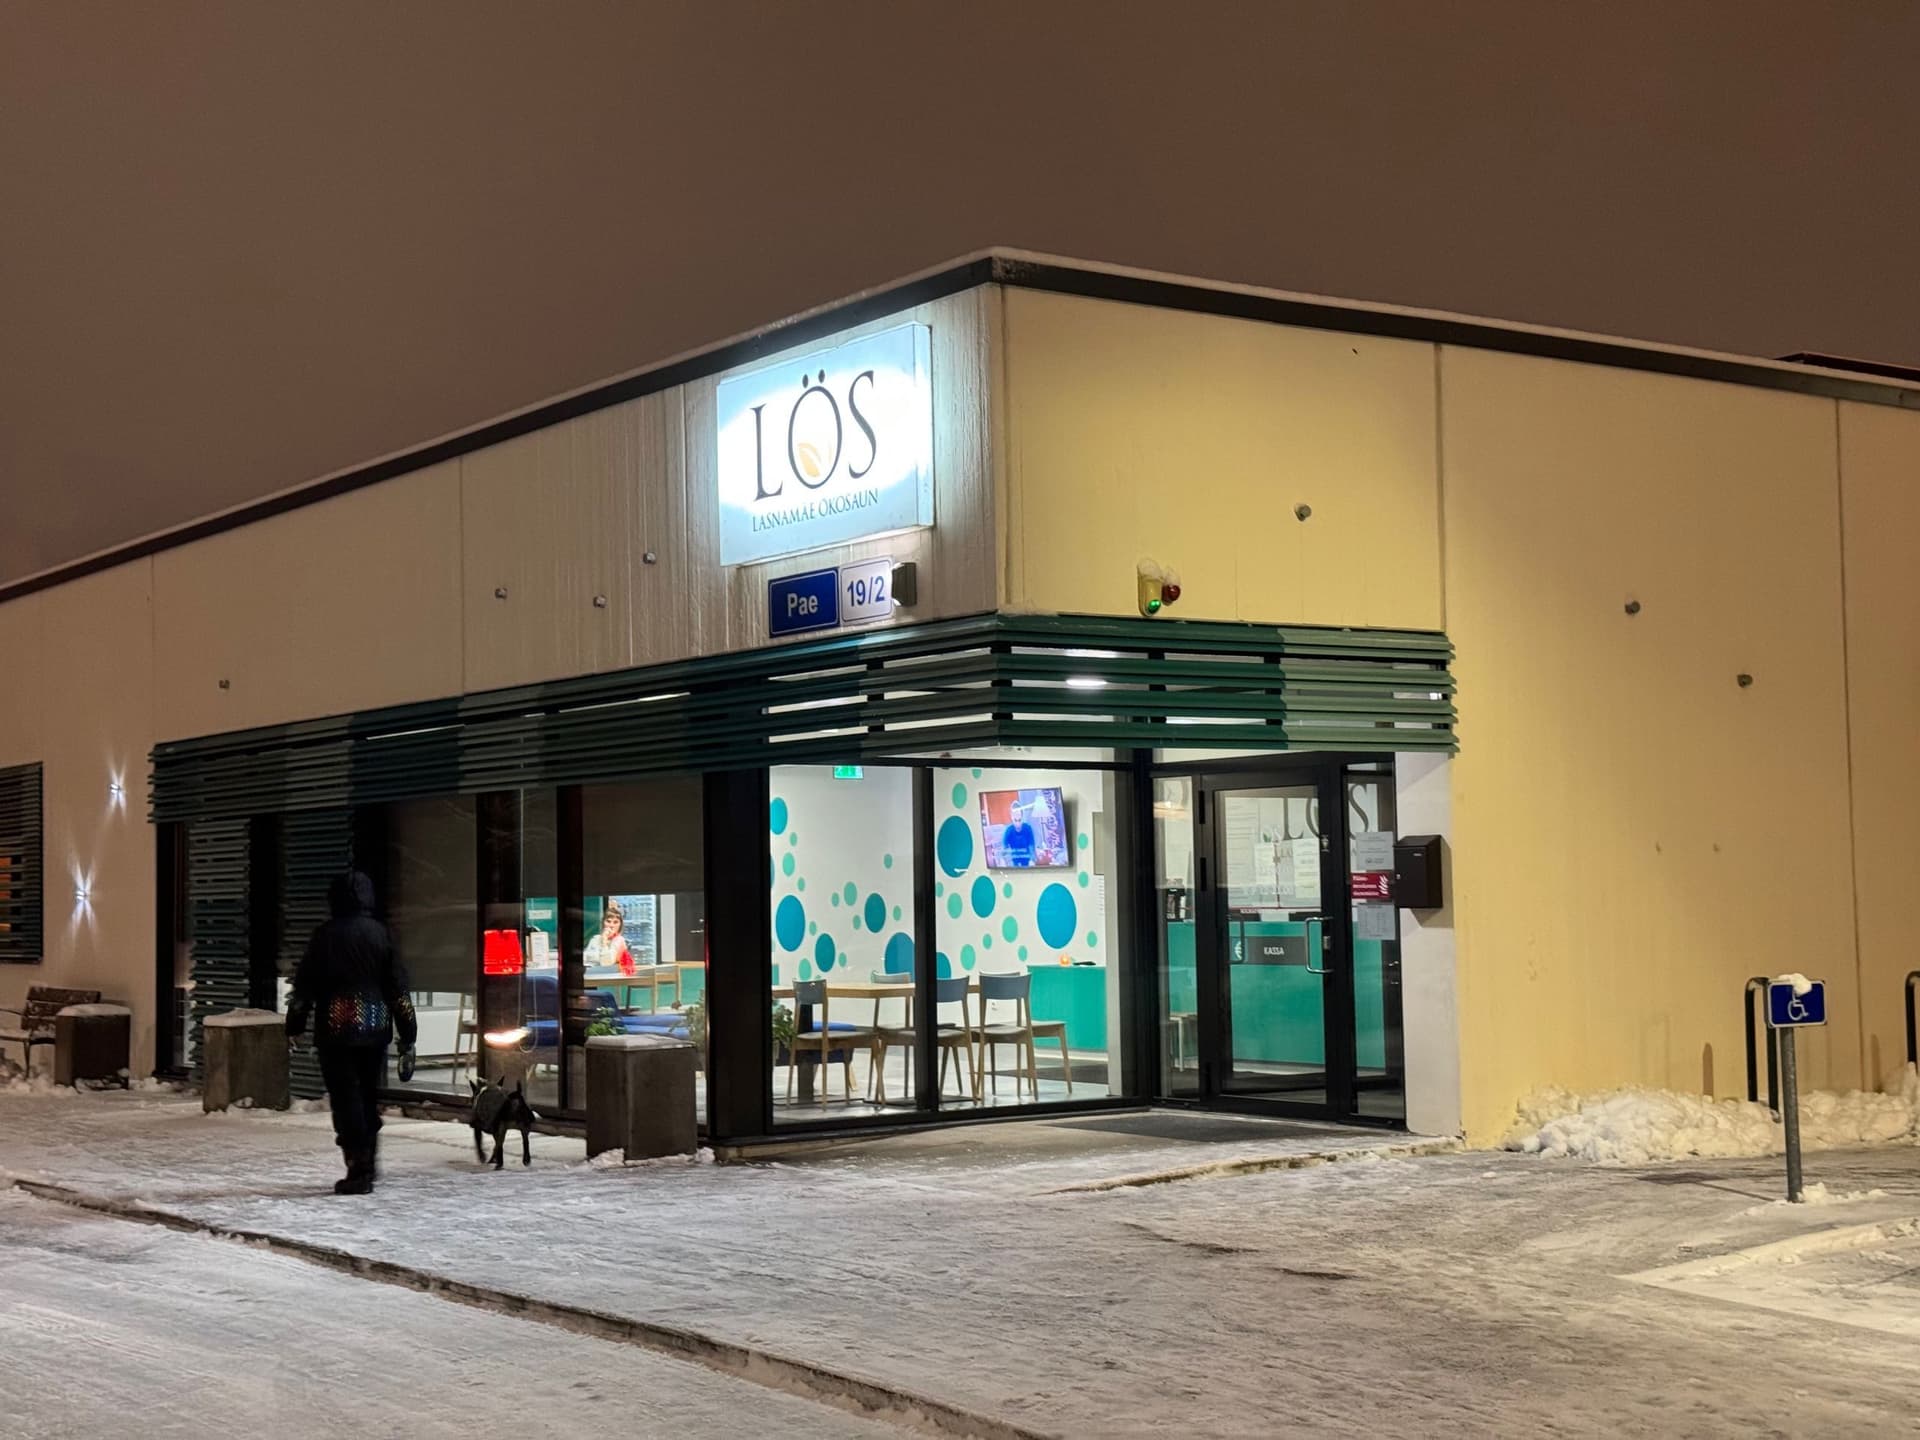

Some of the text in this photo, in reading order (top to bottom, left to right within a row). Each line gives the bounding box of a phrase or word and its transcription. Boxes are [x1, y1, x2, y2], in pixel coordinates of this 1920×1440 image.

[749, 369, 877, 502] LÖS
[787, 592, 819, 618] Pae
[847, 575, 886, 607] 19/2
[1263, 946, 1285, 955] KASSA
